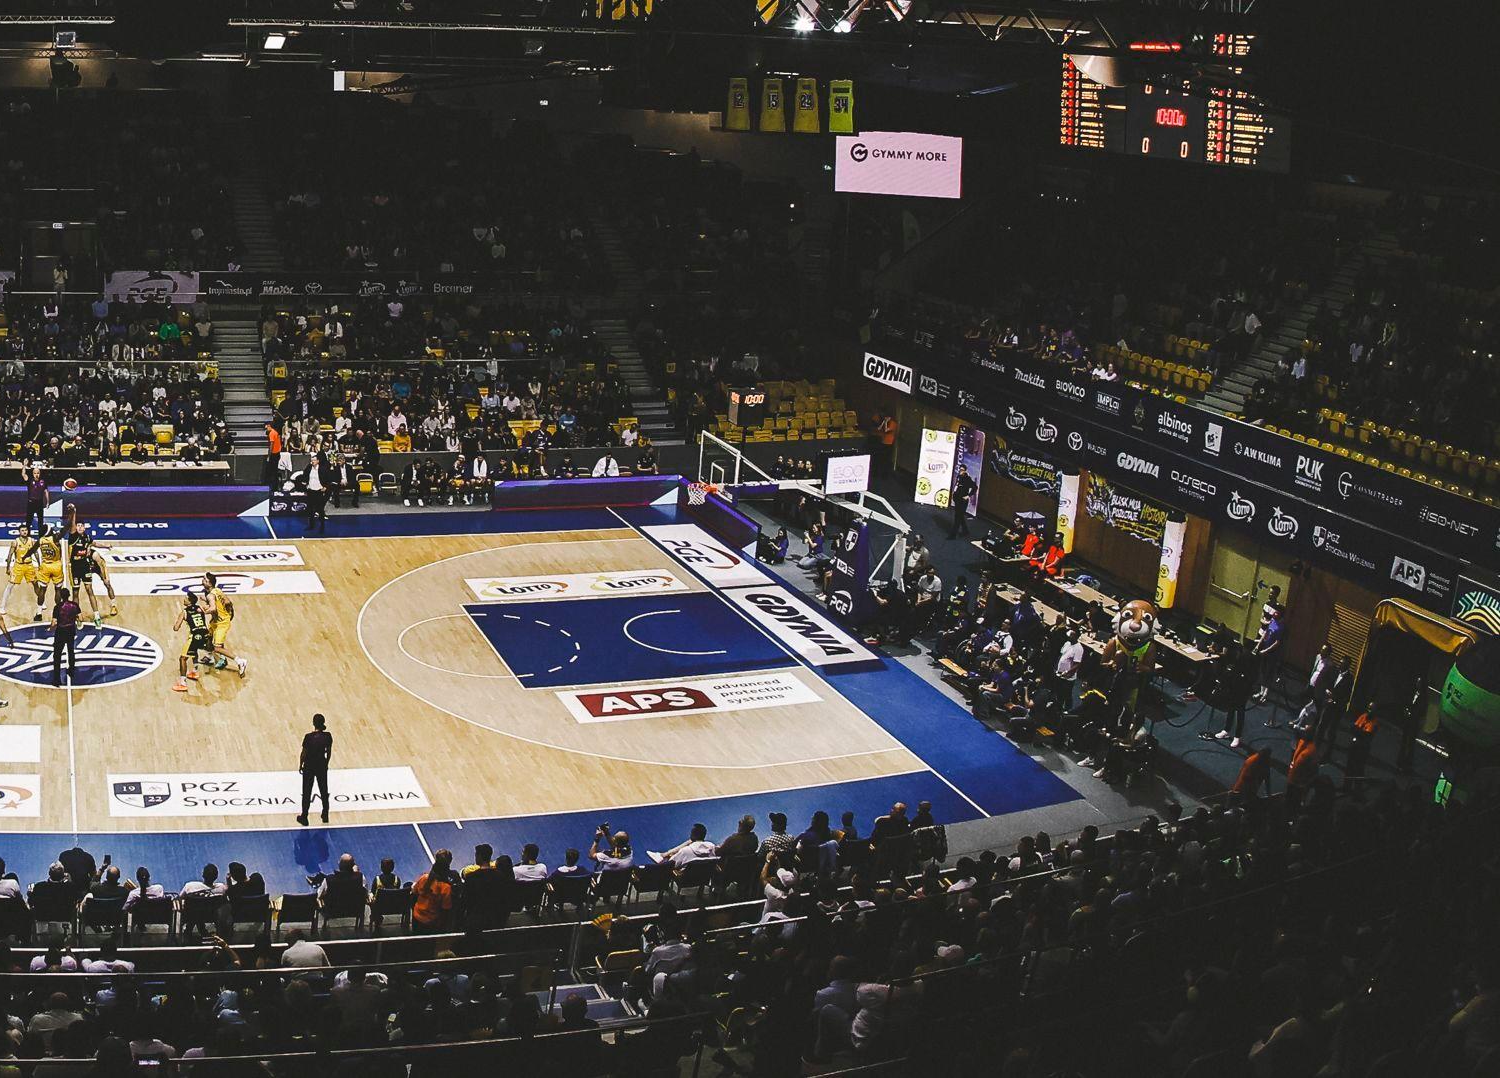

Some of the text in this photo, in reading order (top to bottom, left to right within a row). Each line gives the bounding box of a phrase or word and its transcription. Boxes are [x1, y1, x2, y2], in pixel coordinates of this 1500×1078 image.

[1141, 137, 1188, 158] 0 0
[872, 148, 947, 162] GYMMY MORE
[865, 357, 911, 387] GDYNIA
[744, 393, 765, 405] 10:00
[1157, 411, 1192, 435] albinos
[1117, 452, 1160, 479] GDYNIA
[1258, 450, 1282, 468] KLIMA
[1295, 455, 1325, 482] PUK
[1171, 470, 1217, 496] asseco
[98, 521, 168, 529] arena
[1425, 509, 1479, 537] ISO-NET
[1326, 531, 1341, 544] PGZ
[112, 553, 167, 563] LOTTO
[223, 552, 278, 562] LOTTO
[661, 539, 715, 564] PGE
[1395, 563, 1421, 584] APS
[150, 583, 241, 594] PGE
[496, 583, 552, 595] LOTTO
[605, 577, 658, 589] LOTTO
[829, 595, 848, 616] PGE
[745, 593, 855, 657] GDYNIA
[713, 679, 781, 690] advanced
[719, 685, 793, 698] protection
[601, 690, 695, 714] APS
[726, 693, 785, 704] systems
[181, 782, 240, 793] PGZ
[183, 796, 296, 807] STOCZNIA
